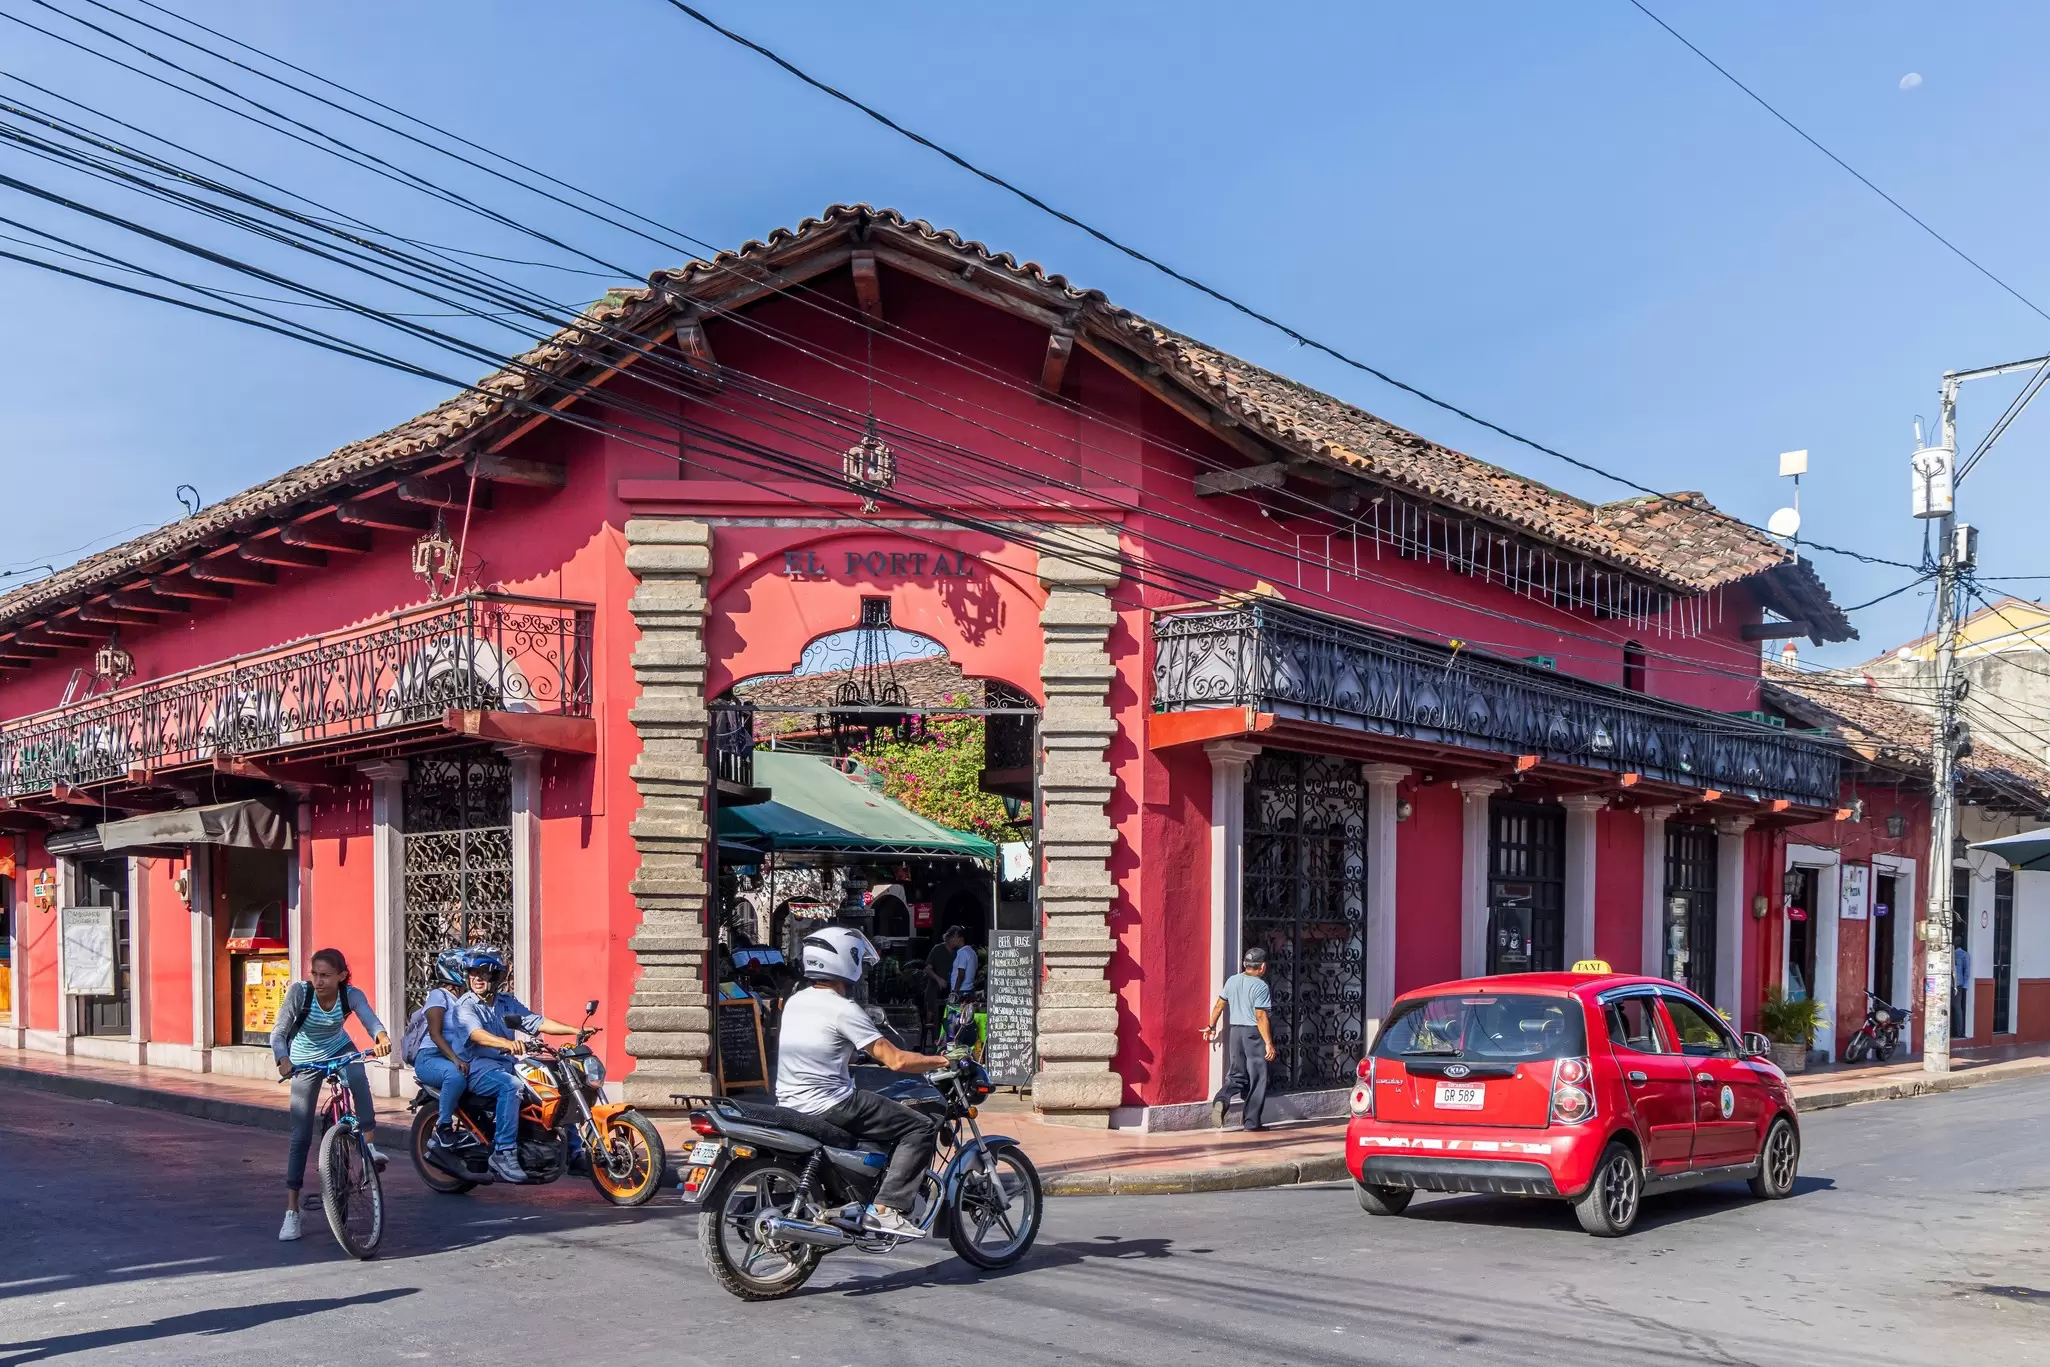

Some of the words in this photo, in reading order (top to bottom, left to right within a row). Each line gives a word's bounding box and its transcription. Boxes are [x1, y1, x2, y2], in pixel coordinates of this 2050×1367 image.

[783, 551, 825, 574] EL
[844, 551, 974, 576] PORTAL
[998, 935, 1012, 948] BEER
[1014, 935, 1032, 948] HOUSE
[1576, 963, 1601, 971] TAXI
[1444, 1089, 1456, 1102] GR
[1458, 1089, 1475, 1102] 589
